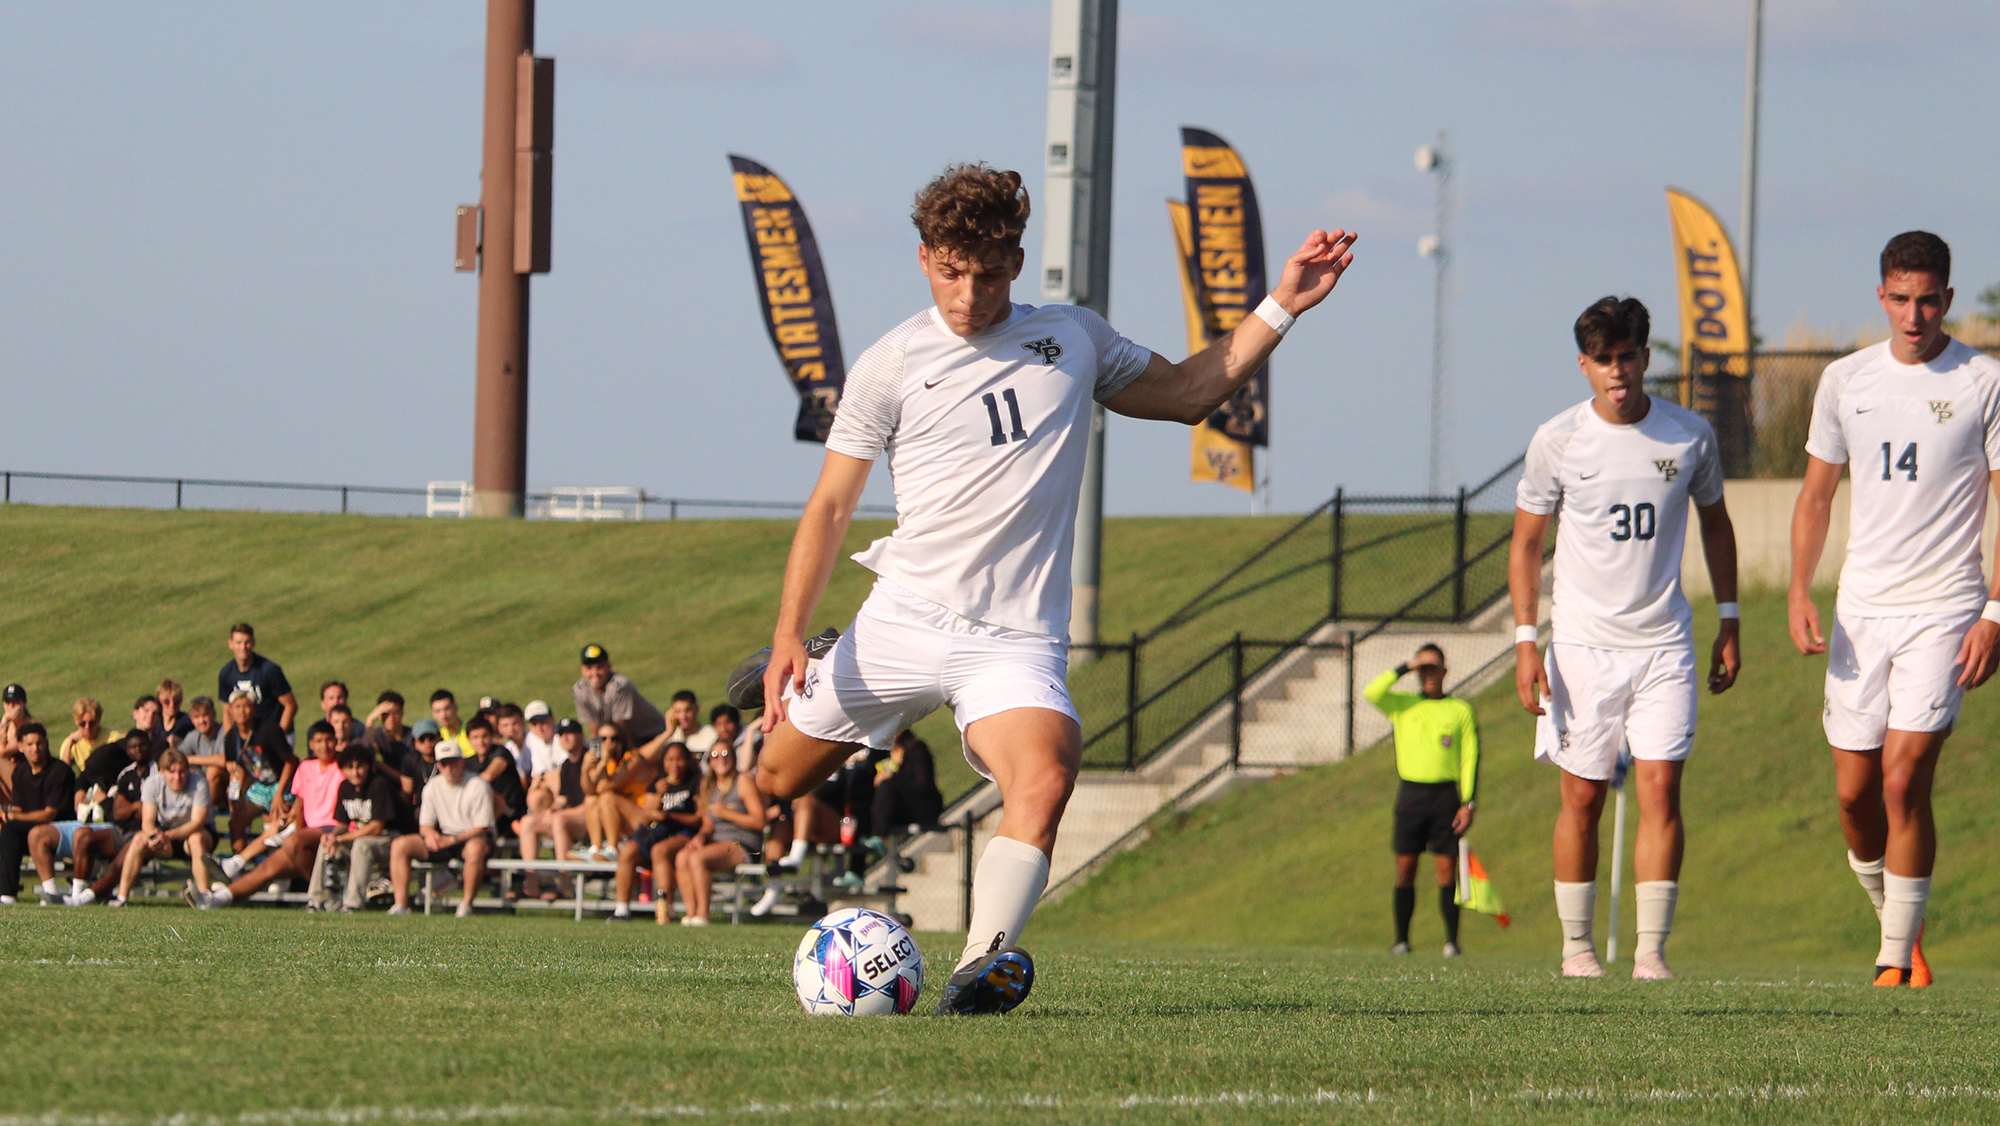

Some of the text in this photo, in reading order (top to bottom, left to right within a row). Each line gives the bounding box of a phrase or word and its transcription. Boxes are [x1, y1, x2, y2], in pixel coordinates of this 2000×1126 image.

[1021, 336, 1063, 366] WP
[981, 388, 1029, 446] 11
[1926, 400, 1953, 424] WP
[1653, 458, 1679, 483] WP
[1881, 442, 1918, 481] 14
[1609, 503, 1655, 541] 30
[863, 935, 916, 981] SELECT
